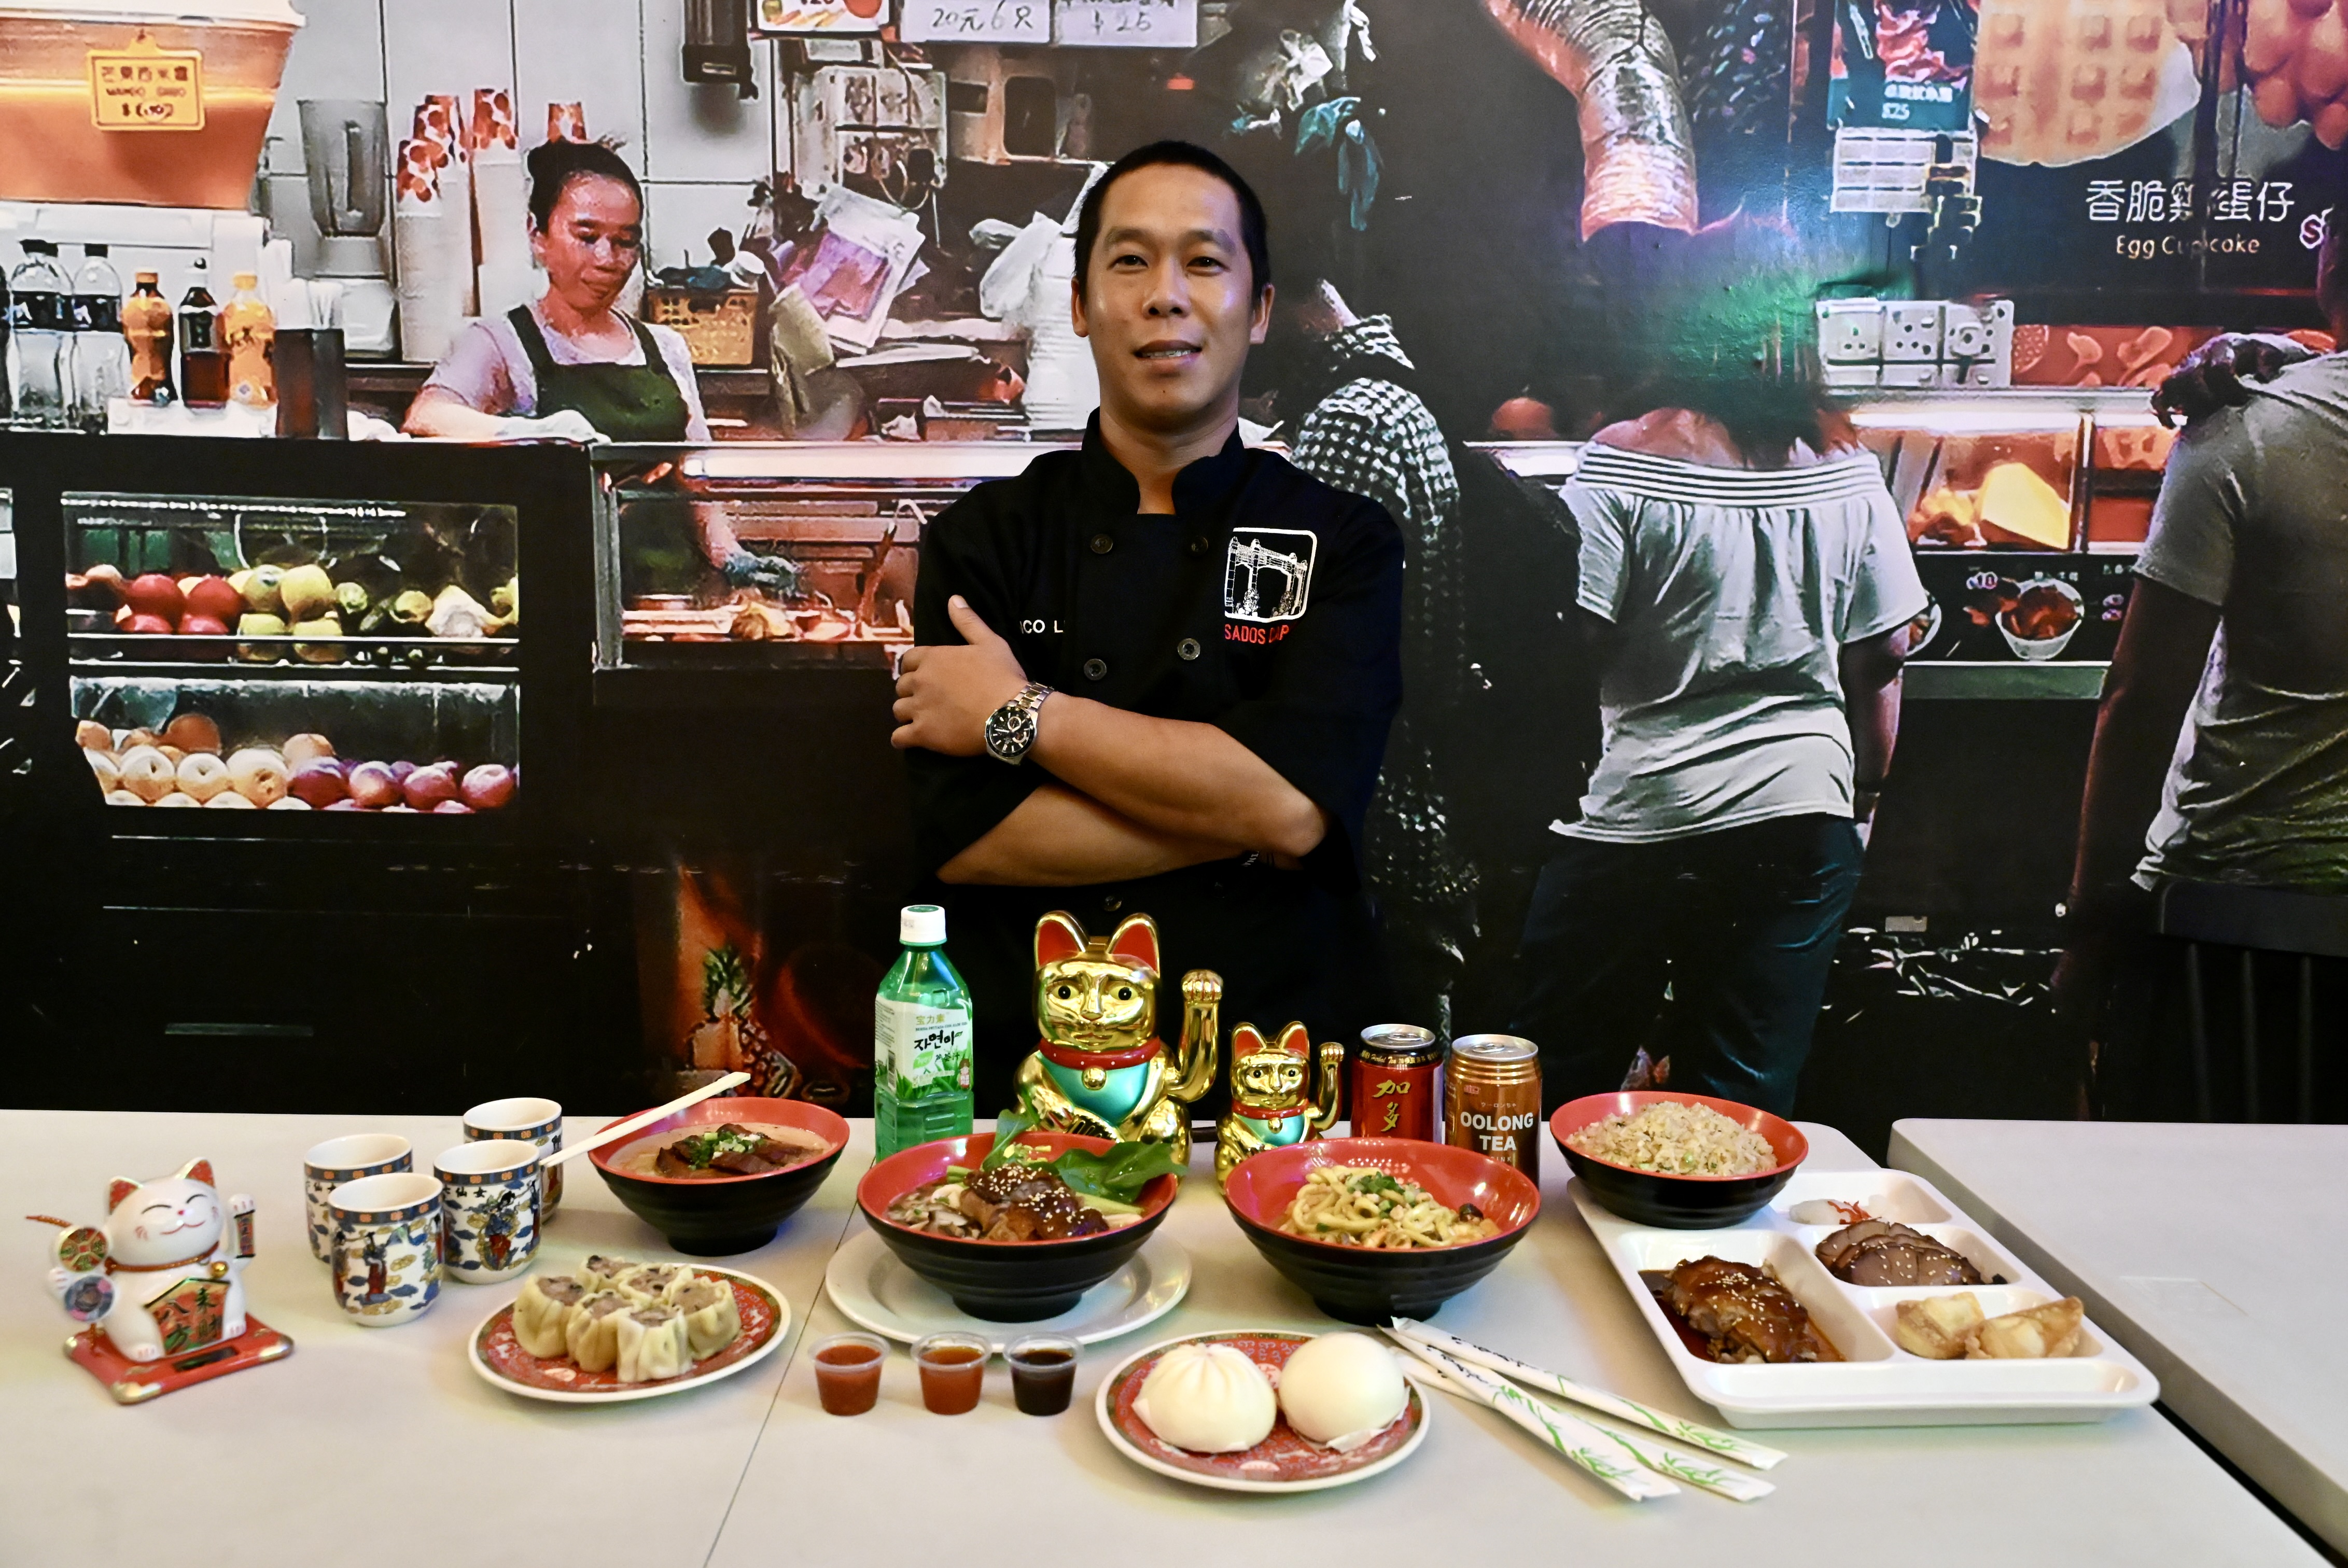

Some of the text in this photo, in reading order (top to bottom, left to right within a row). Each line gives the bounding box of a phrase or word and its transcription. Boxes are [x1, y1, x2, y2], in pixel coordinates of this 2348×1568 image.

[2116, 234, 2156, 259] Egg
[1460, 1111, 1533, 1131] OOLONG
[1479, 1135, 1517, 1151] TEA
